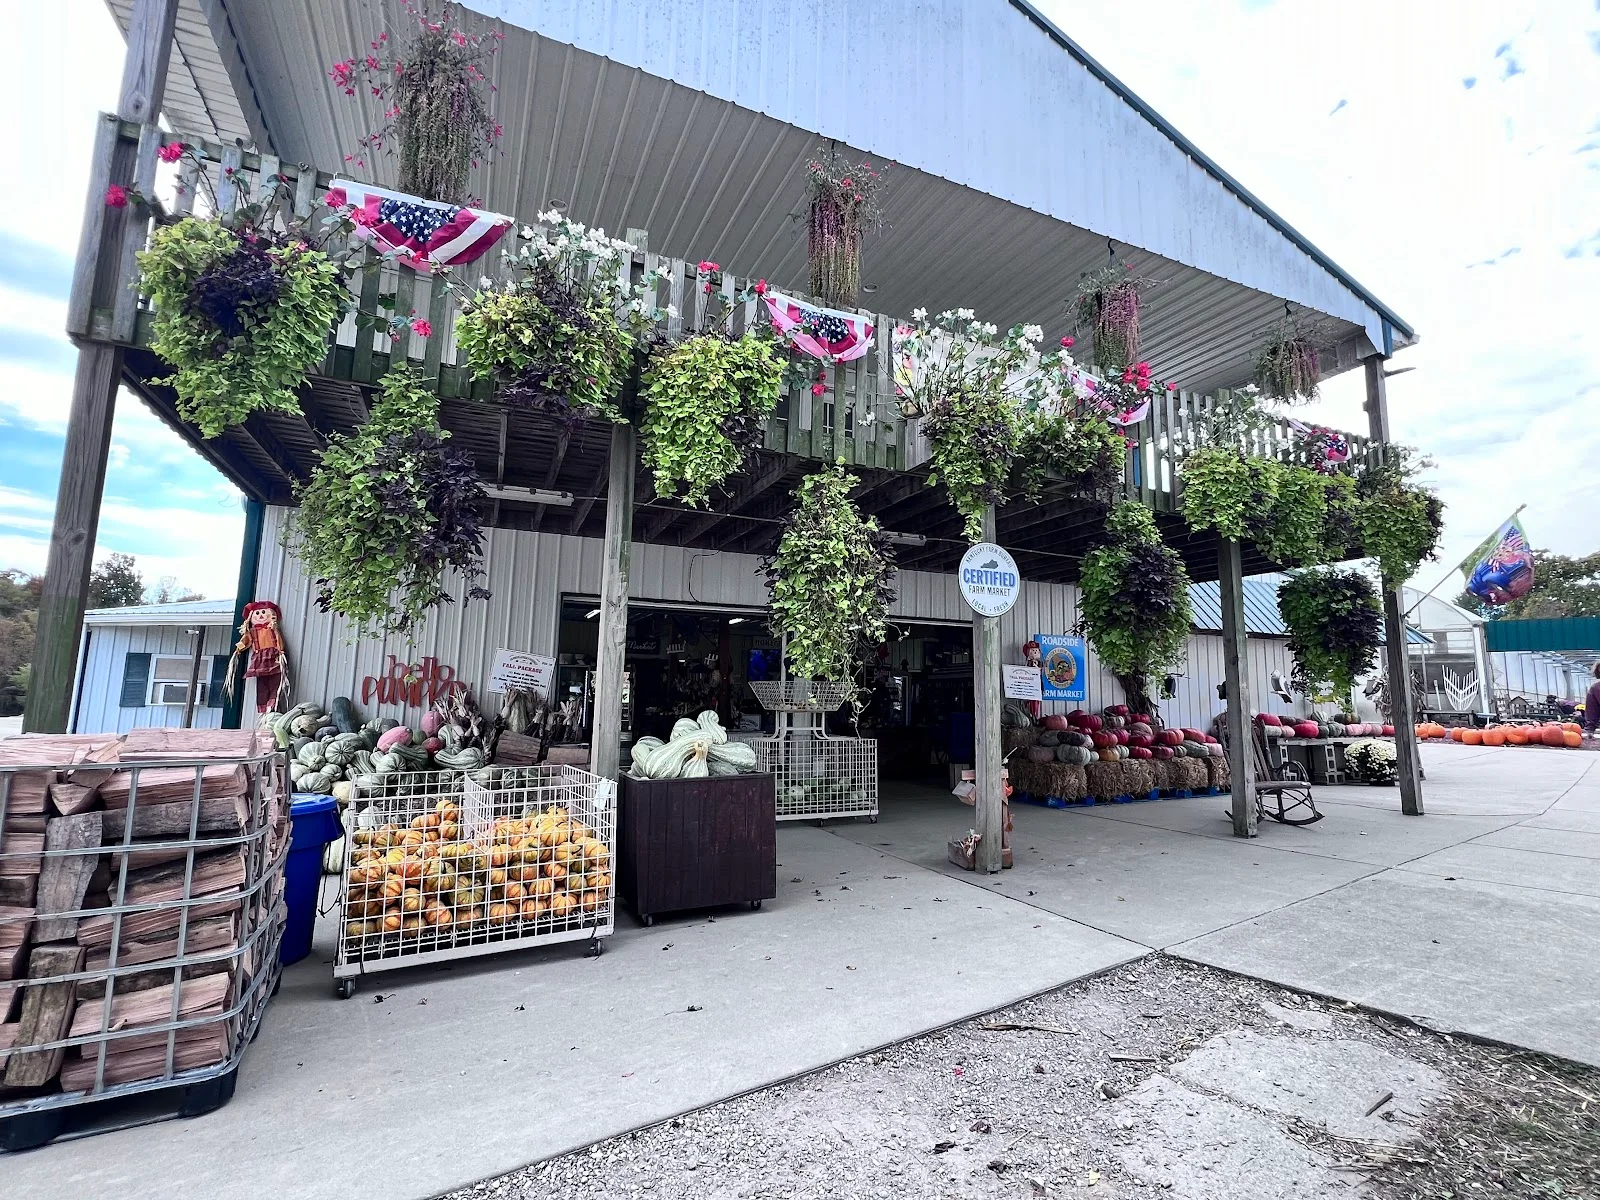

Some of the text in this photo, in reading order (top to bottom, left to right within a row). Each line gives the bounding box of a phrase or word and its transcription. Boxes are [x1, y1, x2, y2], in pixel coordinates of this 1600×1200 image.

[965, 545, 1014, 568] KENTUCKY FARM BUREAU
[963, 568, 1015, 587] CERTIFIED
[968, 584, 1011, 597] FARM MARKET
[971, 598, 1009, 613] LOCAL FRESH
[1041, 636, 1079, 647] ROADSIDE
[387, 654, 455, 682] hello
[501, 662, 517, 670] FALL
[517, 665, 543, 674] PACKAGE
[1057, 689, 1084, 699] MARKET
